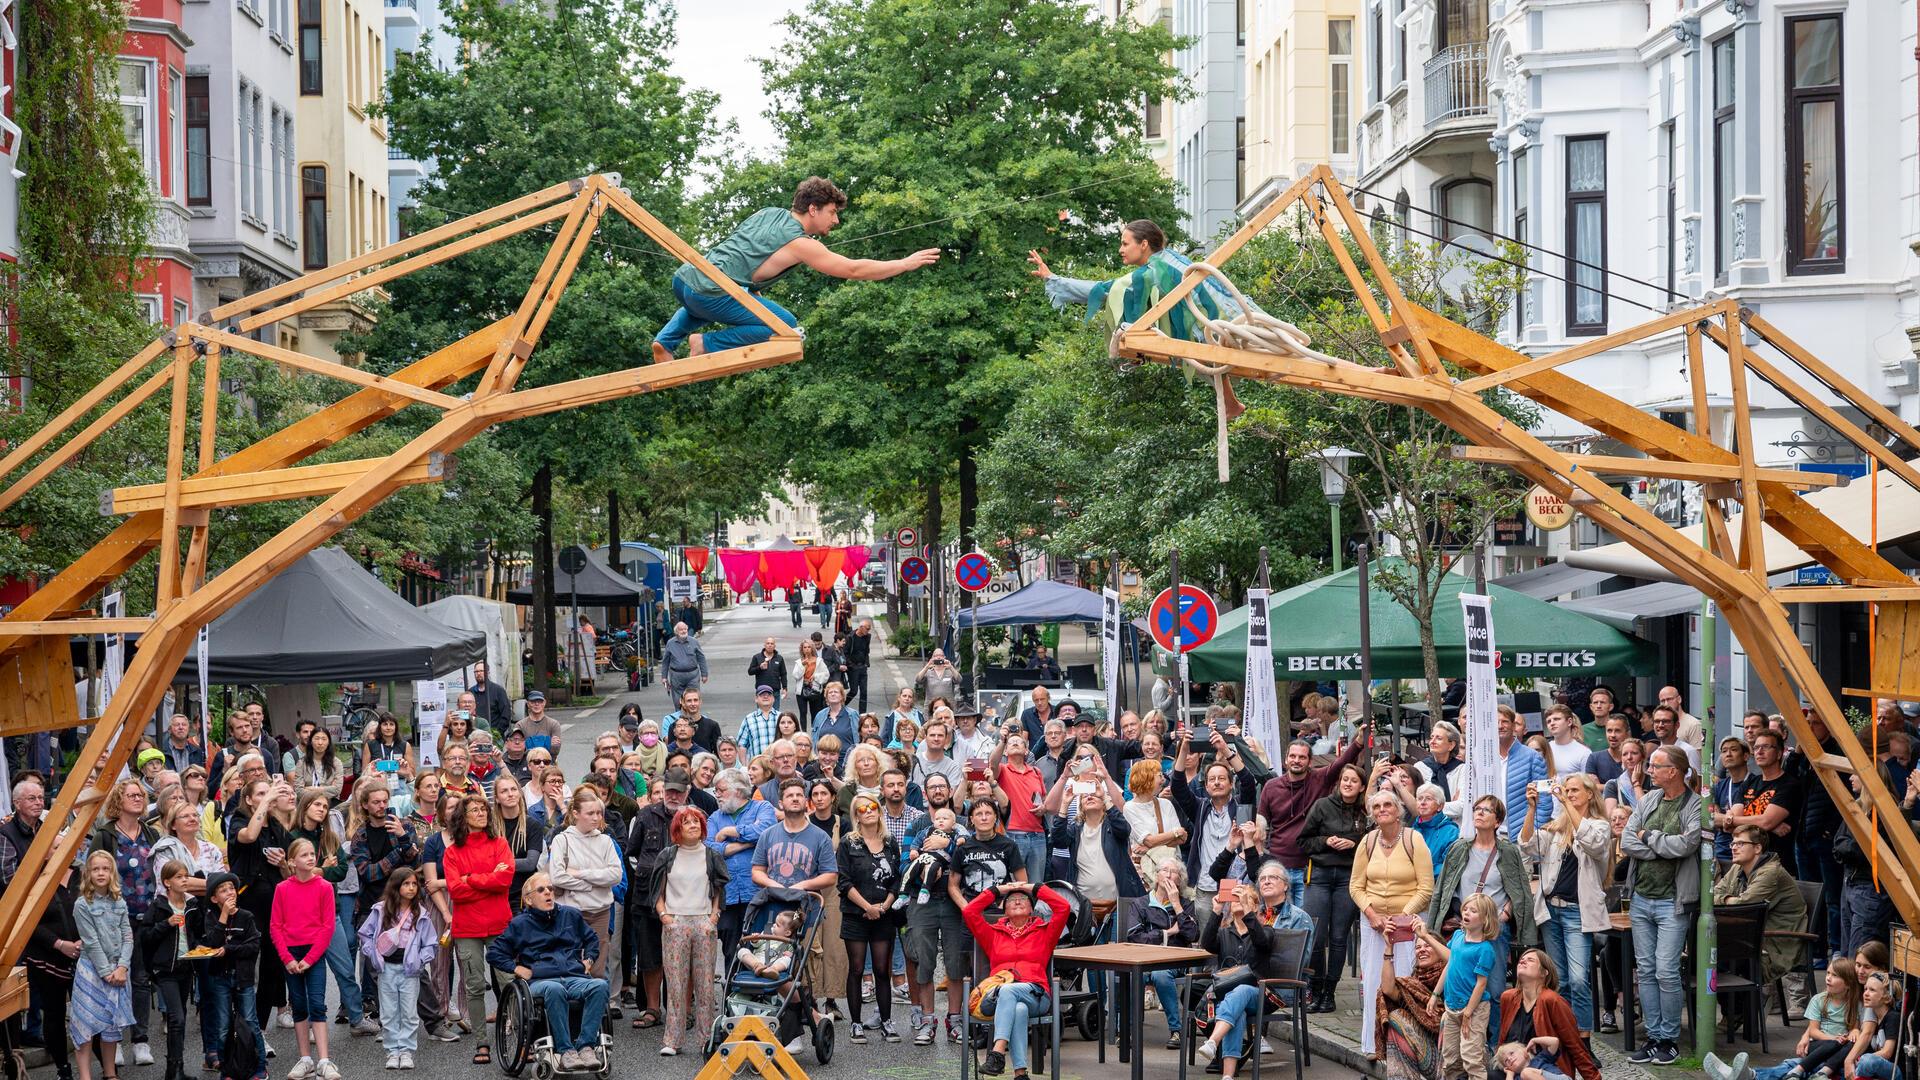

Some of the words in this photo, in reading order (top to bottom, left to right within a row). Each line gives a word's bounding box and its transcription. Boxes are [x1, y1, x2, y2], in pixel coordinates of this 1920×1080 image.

[1534, 496, 1565, 504] HAAK
[1539, 505, 1564, 515] BECK
[1516, 649, 1596, 667] BECK'S
